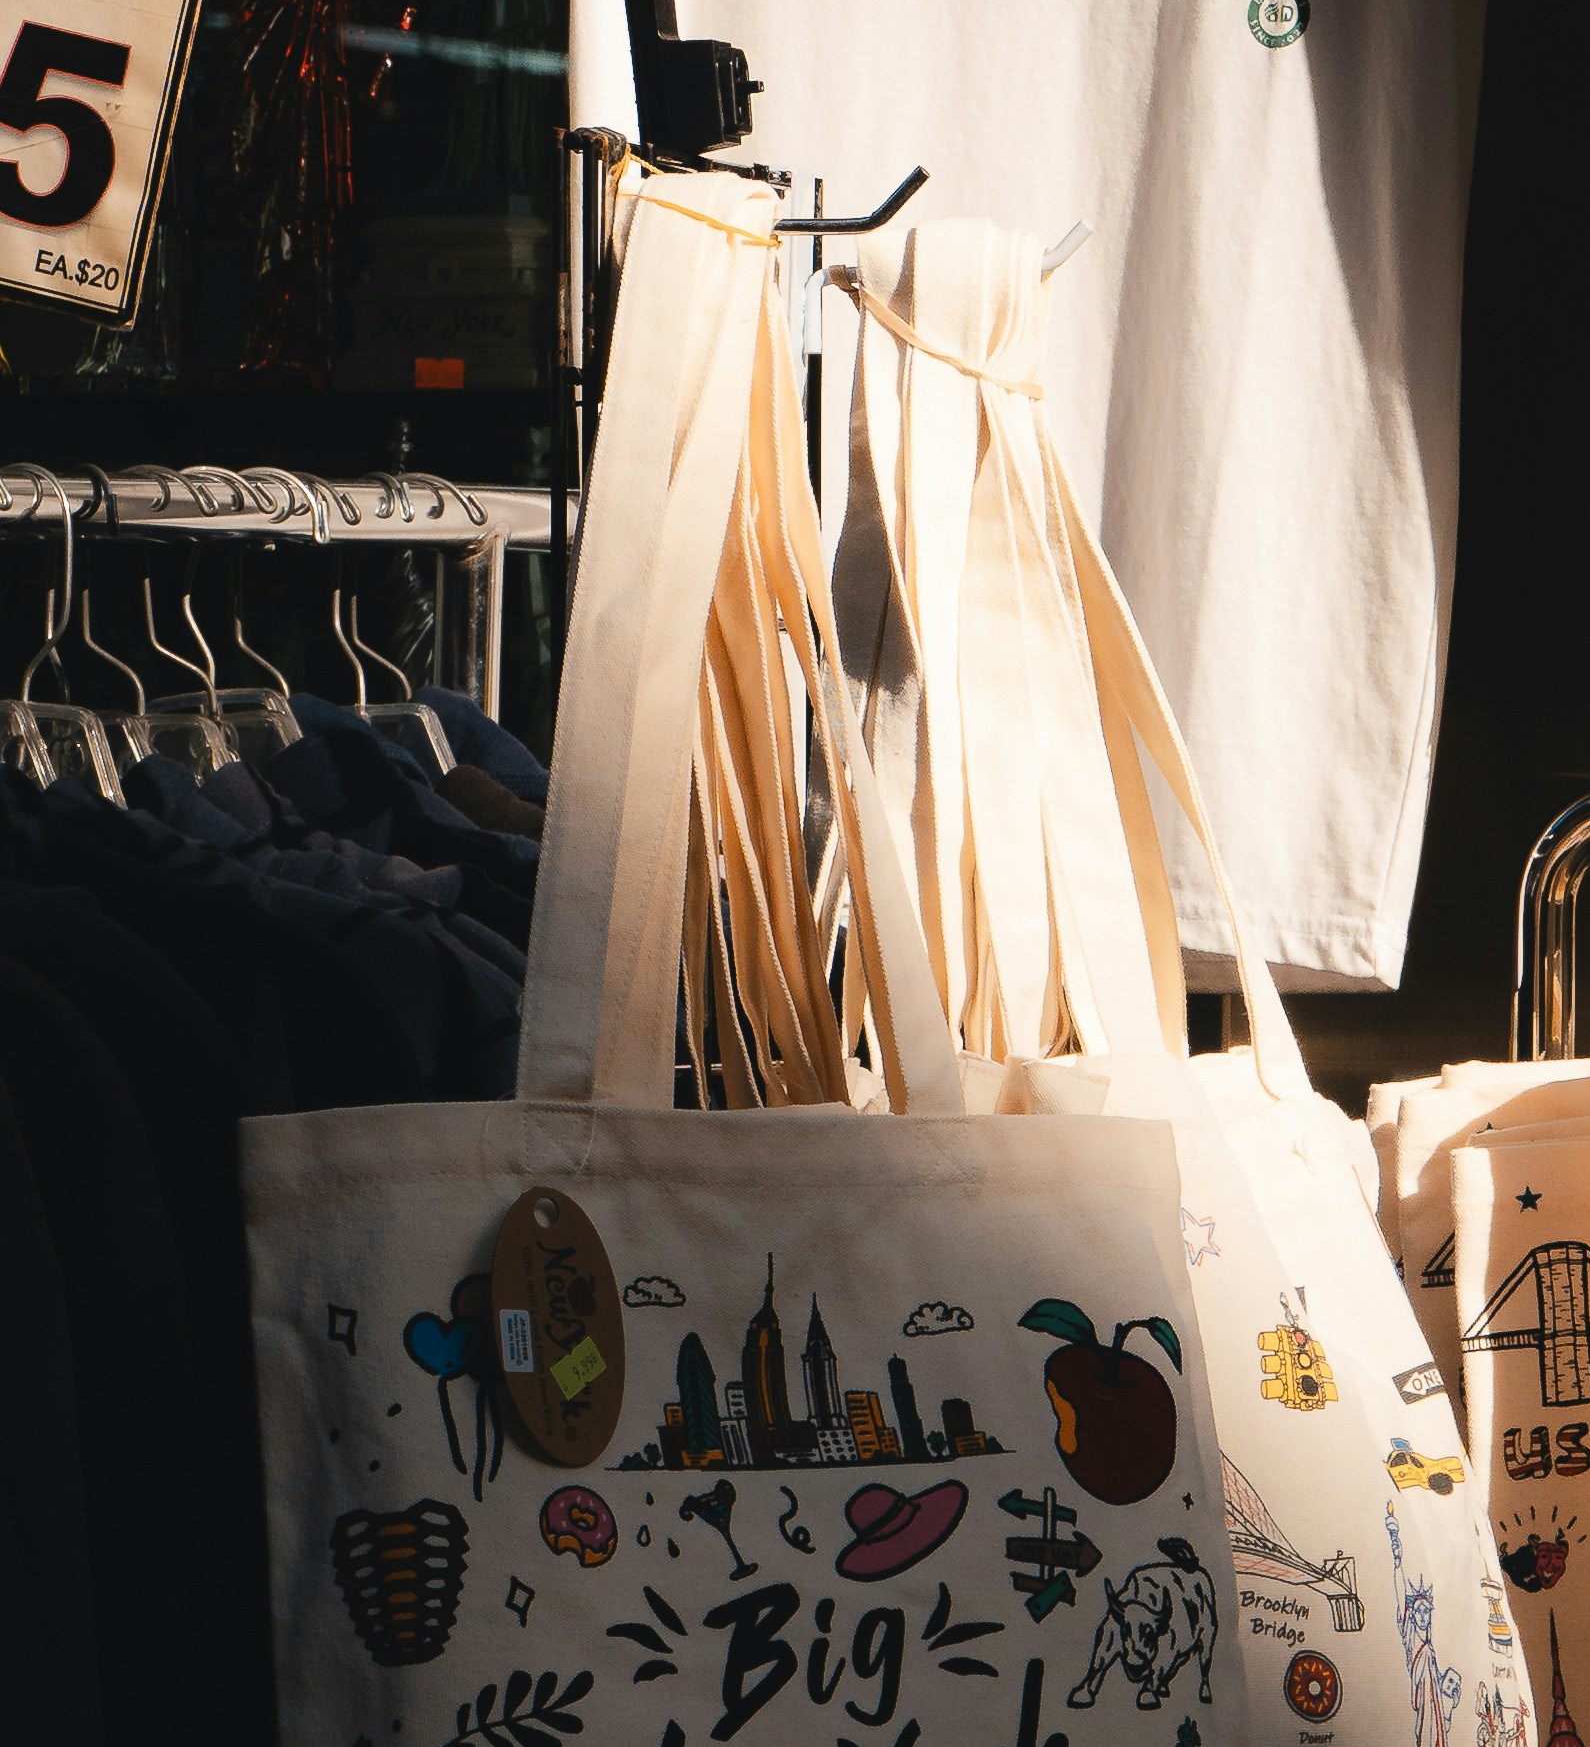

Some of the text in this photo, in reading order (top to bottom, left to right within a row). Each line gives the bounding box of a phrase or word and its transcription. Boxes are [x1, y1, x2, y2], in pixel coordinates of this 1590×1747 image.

[34, 250, 120, 292] EA.$20
[1239, 1589, 1310, 1620] Brooklyn
[1250, 1617, 1306, 1648] Bridge
[702, 1582, 905, 1742] Big
[1298, 1730, 1336, 1746] Donut
